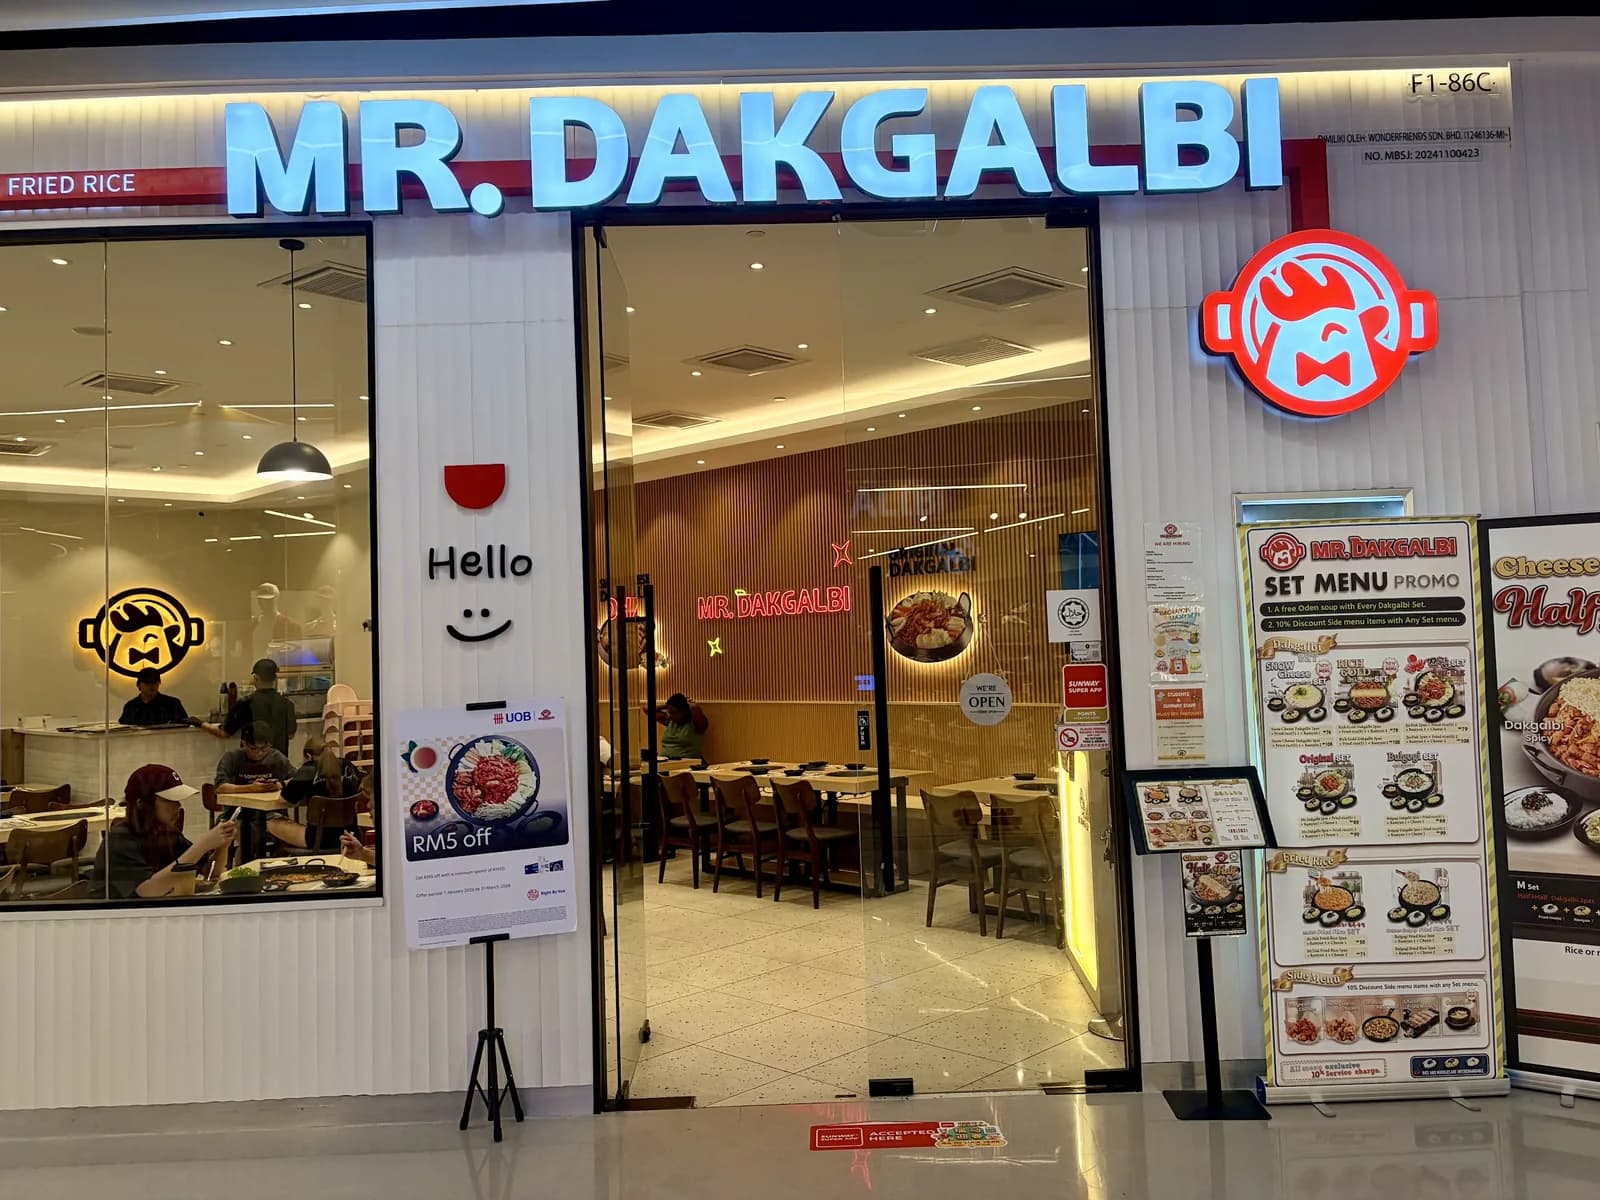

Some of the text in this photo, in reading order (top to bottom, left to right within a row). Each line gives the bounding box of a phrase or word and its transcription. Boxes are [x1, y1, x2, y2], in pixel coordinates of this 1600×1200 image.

[1411, 72, 1492, 94] F1-86C
[1368, 131, 1427, 142] WONDERFRIENDS
[225, 77, 1282, 217] MR. DAKGALBI
[1365, 148, 1480, 160] NO. MBSJ: 20241100423
[7, 172, 136, 197] FRIED RICE
[428, 544, 533, 580] Hello
[889, 556, 976, 577] DAKGALBI
[1265, 571, 1460, 596] SET MENU PROMO
[698, 586, 850, 620] MR. DAKGALBI
[1298, 604, 1319, 612] Oden
[1321, 604, 1338, 612] soup
[1339, 602, 1355, 610] with
[1357, 602, 1377, 611] Every
[1378, 601, 1410, 610] Dakgalbi
[1268, 621, 1274, 629] 2.
[1292, 619, 1326, 628] Discount
[1328, 618, 1342, 626] Side
[1343, 618, 1365, 626] menu
[1387, 616, 1403, 625] with
[1404, 616, 1420, 625] Any
[1422, 615, 1435, 624] Set
[1273, 639, 1322, 653] Dakgalbi
[1265, 661, 1296, 671] SNOW
[1277, 670, 1312, 679] Cheese
[1068, 680, 1099, 688] SUNWAY
[968, 696, 1006, 708] OPEN
[505, 711, 531, 722] UOB
[1504, 720, 1565, 733] Dakgalbi
[1299, 753, 1334, 765] Original
[413, 827, 492, 853] RM5 off
[1282, 852, 1335, 868] Fried Rice
[1516, 880, 1540, 891] M Set
[1564, 945, 1583, 955] Rice
[1287, 970, 1341, 985] Side Menu
[1325, 1068, 1353, 1077] Service
